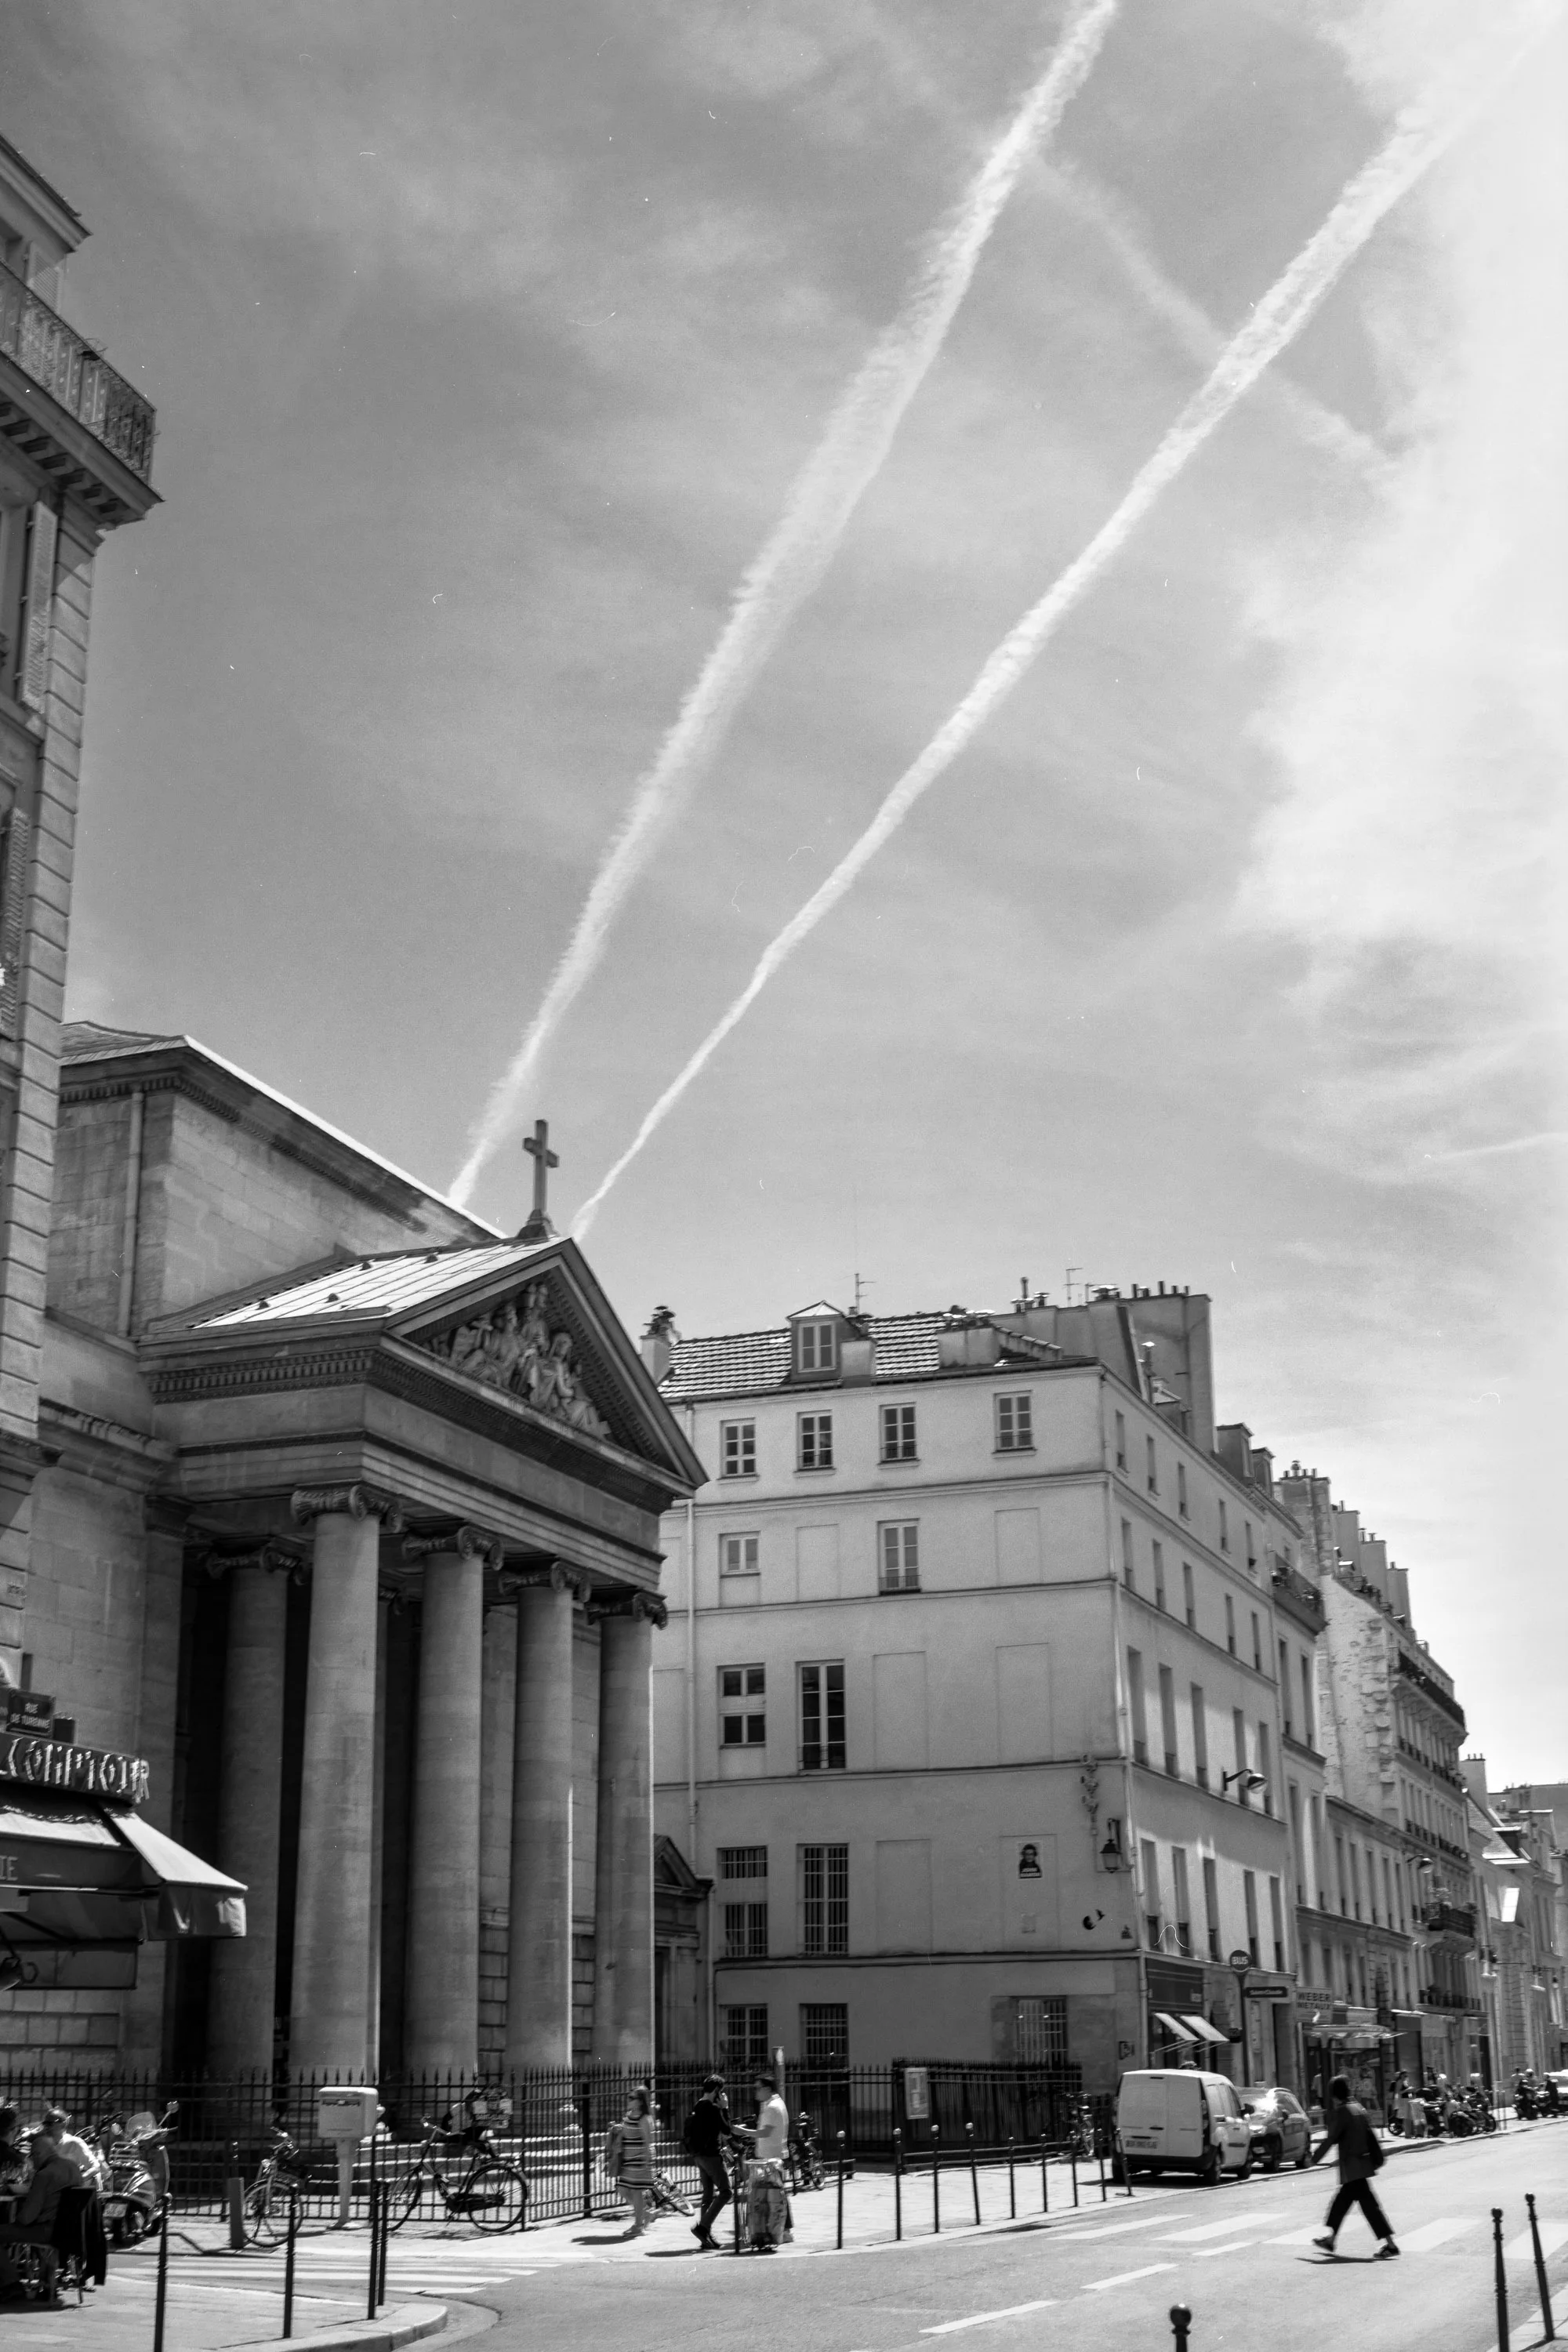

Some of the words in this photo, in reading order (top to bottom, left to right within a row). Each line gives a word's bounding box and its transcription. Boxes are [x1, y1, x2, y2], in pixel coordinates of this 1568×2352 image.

[25, 1702, 38, 1714] RUE
[10, 1713, 20, 1723] DE
[1231, 1956, 1249, 1965] BUS
[1298, 1992, 1331, 2002] WEBER
